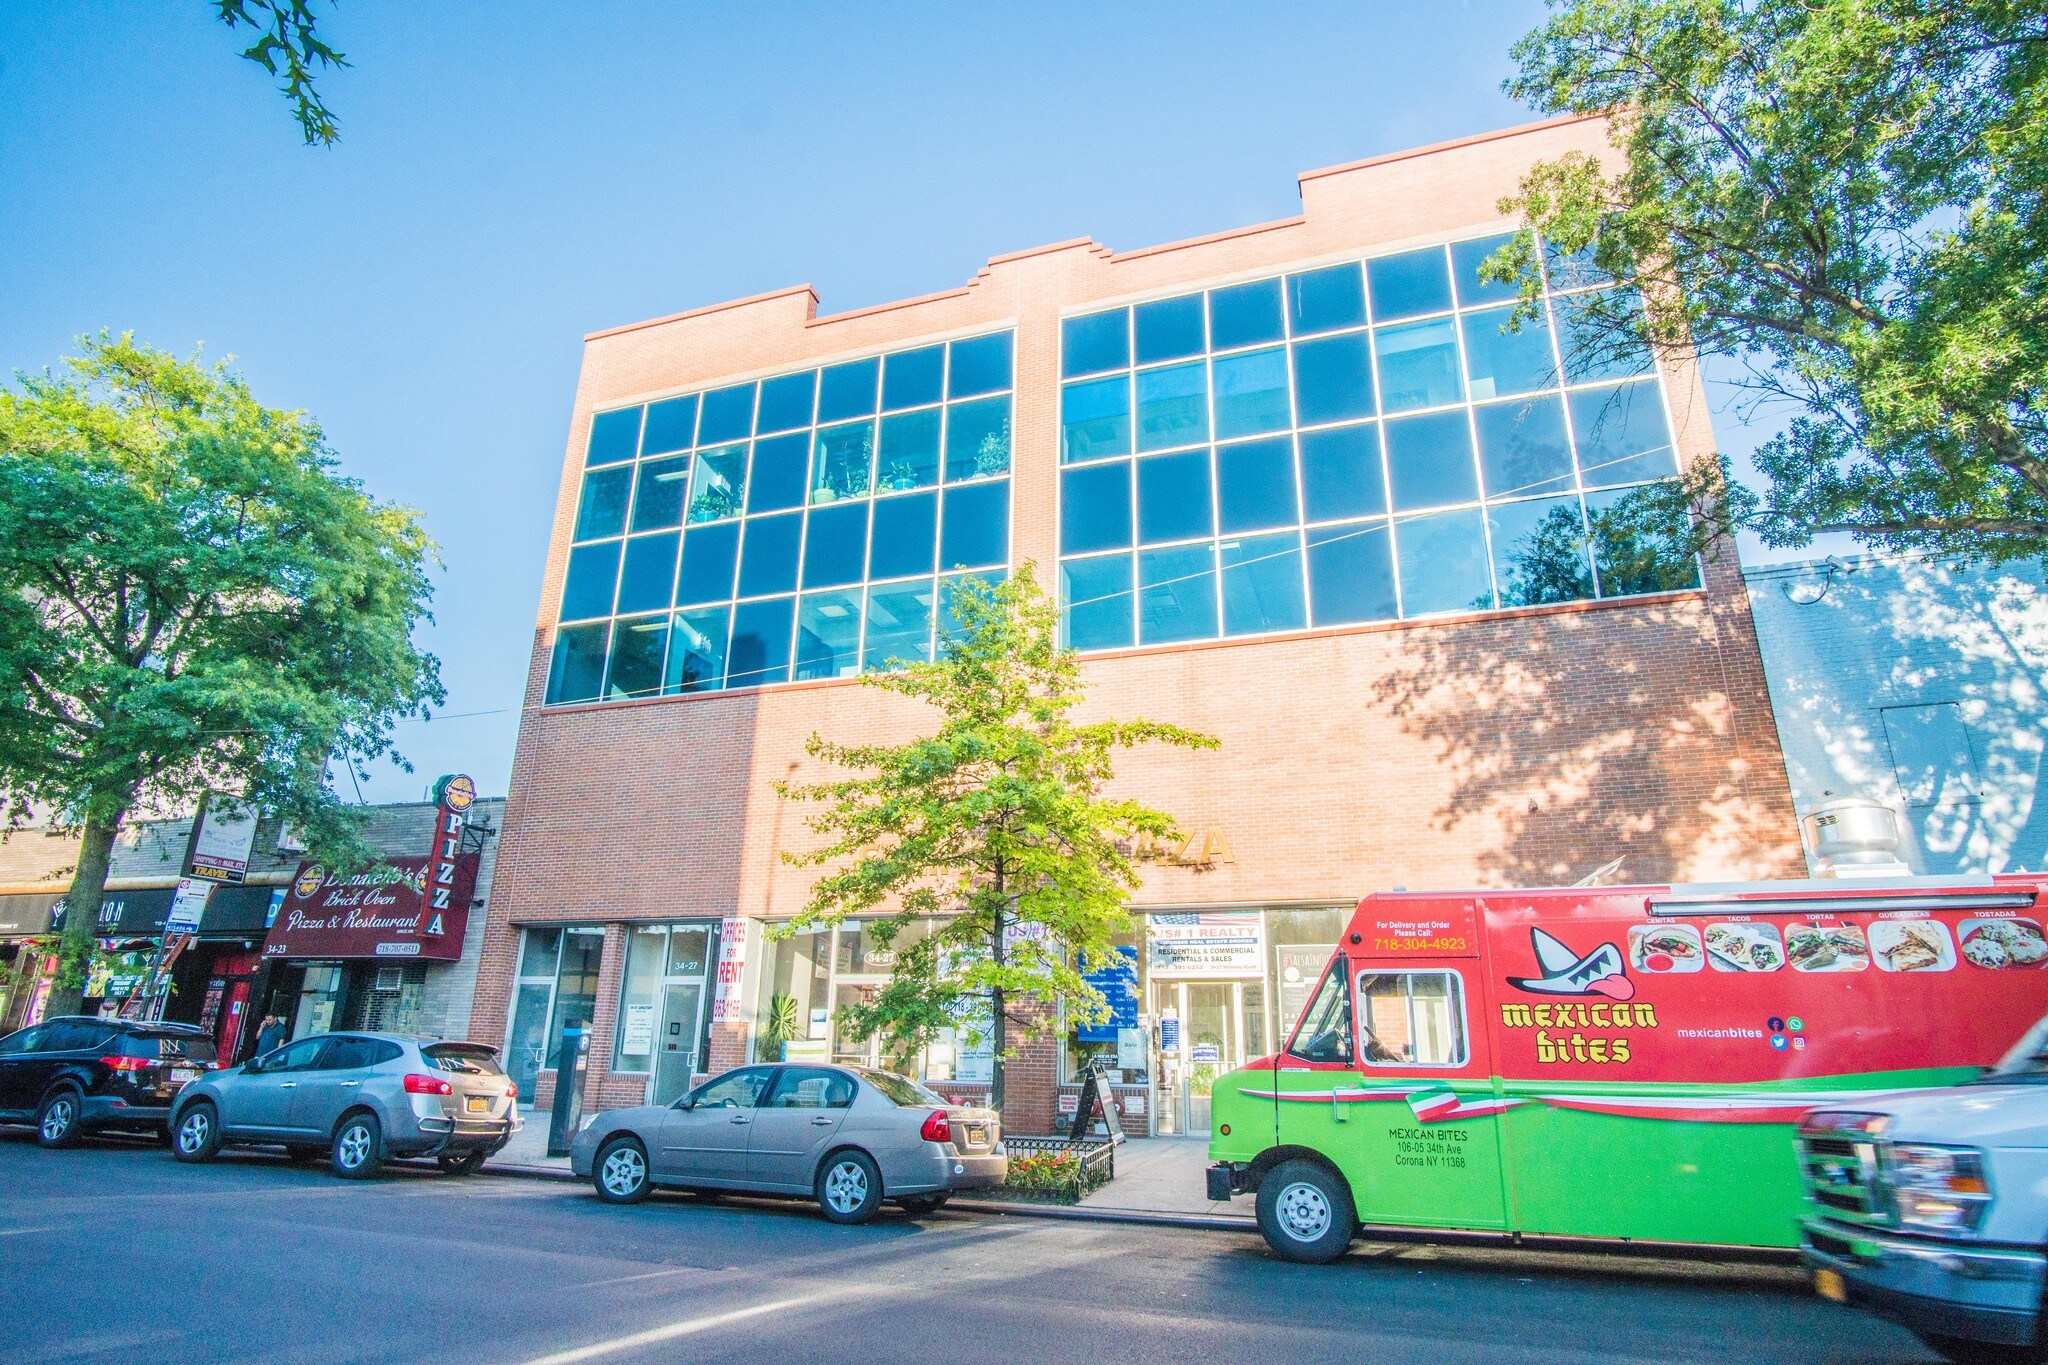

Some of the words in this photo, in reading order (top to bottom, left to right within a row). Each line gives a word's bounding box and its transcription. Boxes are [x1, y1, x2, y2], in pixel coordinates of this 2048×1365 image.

[194, 866, 229, 879] TRAVEL
[427, 813, 463, 935] PIZZA
[323, 888, 362, 907] Brick
[363, 887, 396, 906] Oven
[287, 909, 325, 932] Pizza
[327, 915, 342, 929] &
[342, 908, 421, 929] Restaurant
[1376, 921, 1388, 929] For
[1389, 921, 1416, 930] Delivery
[1417, 921, 1430, 929] and
[1431, 921, 1450, 929] Order
[720, 922, 747, 943] OFFICES
[1186, 929, 1194, 937] 1
[1199, 927, 1256, 938] REALTY
[1394, 929, 1416, 937] Please
[1417, 929, 1433, 937] Call:
[266, 944, 287, 954] 34-23
[378, 944, 419, 953] 718-707-0511
[1374, 937, 1466, 950] 718-304-4923
[727, 948, 737, 957] FOR
[1210, 947, 1255, 955] COMMERCIAL
[868, 953, 895, 963] 34-27
[1172, 955, 1202, 963] RENTALS
[674, 962, 698, 970] 34-27
[718, 961, 744, 983] RENT
[1677, 1027, 1763, 1038] mexicanbites
[1389, 1128, 1434, 1140] MEXICAN
[1437, 1129, 1468, 1141] BITES
[1397, 1141, 1424, 1153] 106-05
[1426, 1142, 1444, 1154] 34th
[1446, 1143, 1462, 1154] Ave
[1395, 1154, 1424, 1166] Corona
[1426, 1156, 1438, 1166] NY
[1441, 1156, 1466, 1168] 11368
